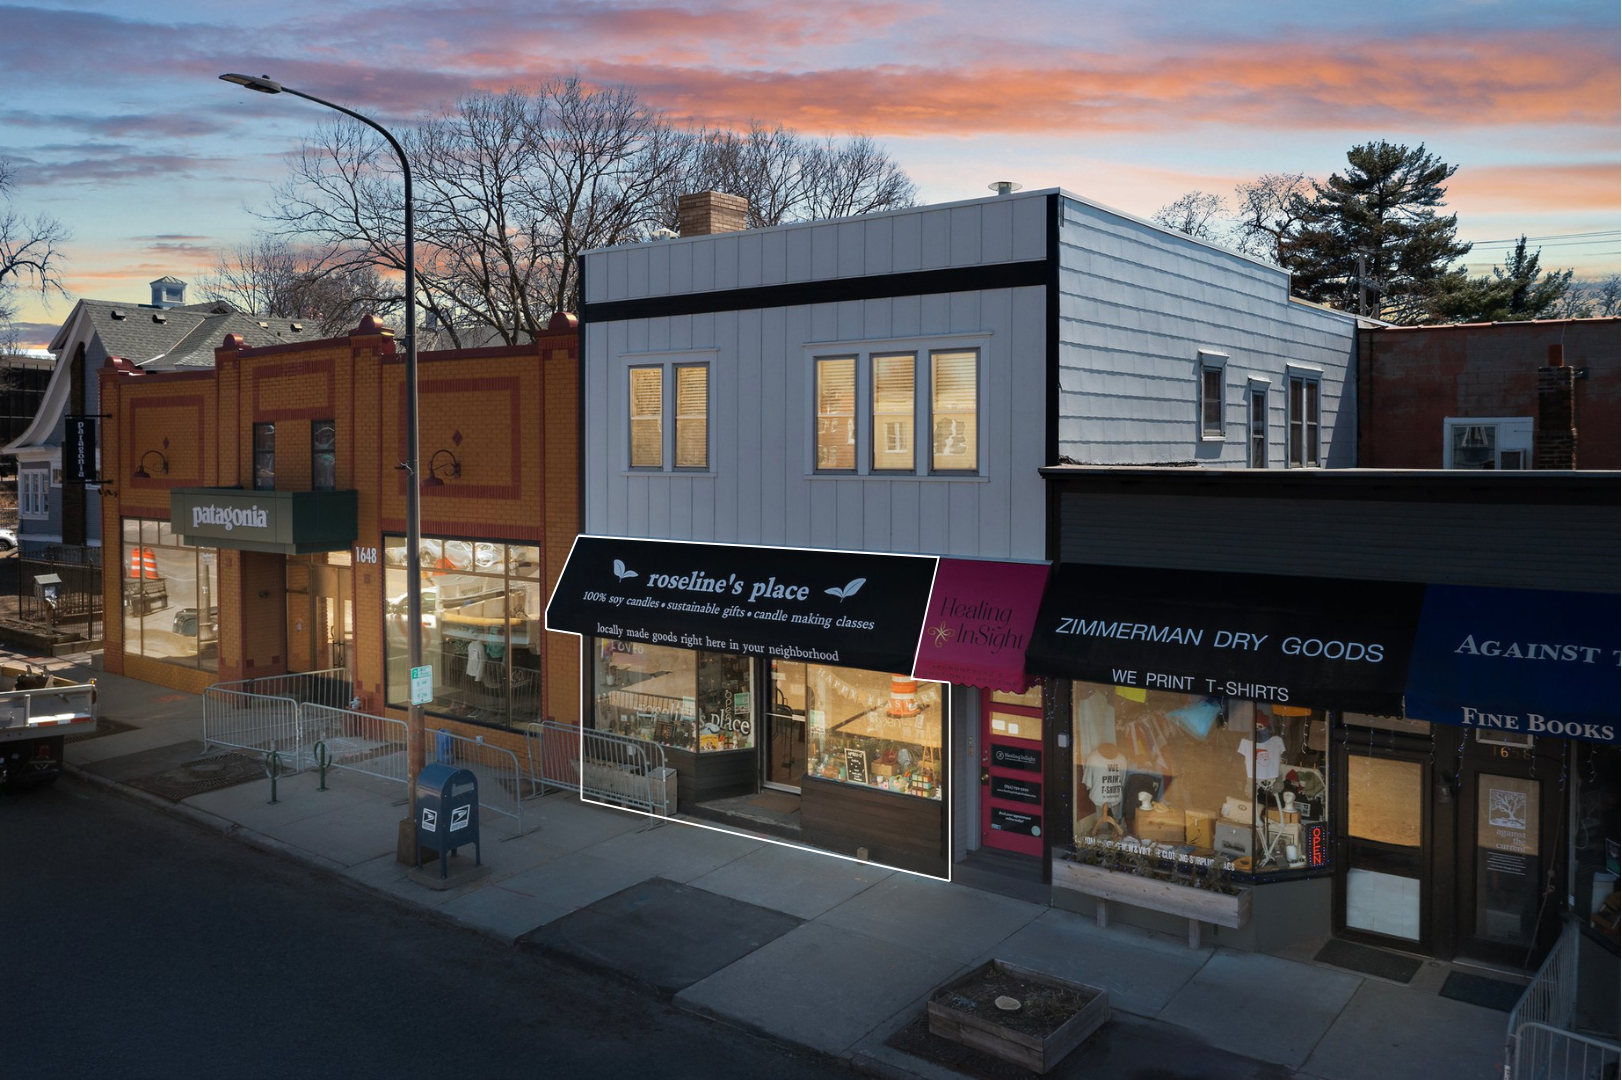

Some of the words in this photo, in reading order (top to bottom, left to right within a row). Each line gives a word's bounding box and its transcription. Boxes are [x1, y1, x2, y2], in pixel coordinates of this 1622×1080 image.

[77, 421, 85, 478] patagonia
[192, 504, 268, 531] patagonia
[355, 546, 377, 564] 1648
[646, 571, 744, 595] roseline's
[747, 577, 810, 603] place
[582, 591, 607, 602] 100%
[608, 595, 625, 607] soy
[626, 597, 660, 609] candles
[666, 602, 721, 615] sustainable
[721, 605, 746, 619] gifts
[753, 609, 788, 622] candle
[790, 613, 833, 629] making
[835, 616, 875, 630] classes
[940, 597, 1012, 629] Healing
[597, 622, 624, 638] locally
[626, 628, 649, 639] made
[652, 631, 678, 643] goods
[680, 633, 703, 647] right
[706, 636, 726, 649] here
[729, 639, 739, 650] in
[742, 643, 765, 654] your
[768, 644, 840, 662] neighborhood
[957, 623, 1023, 654] InSight
[1055, 617, 1204, 646] ZIMMERMAN
[1213, 630, 1269, 652] DRY
[1281, 636, 1385, 663] GOODS
[1454, 634, 1601, 664] AGAINST
[817, 667, 858, 698] HAPPY
[1112, 668, 1137, 685] WE
[1145, 672, 1195, 691] PRINT
[1205, 678, 1290, 702] T-SHIRTS
[710, 708, 751, 734] place
[1461, 706, 1519, 730] FINE
[1526, 713, 1615, 741] BOOKS
[1107, 764, 1119, 772] WE
[1313, 827, 1321, 865] OPEN
[1496, 829, 1526, 838] against
[1496, 843, 1526, 853] current
[1513, 837, 1526, 845] the
